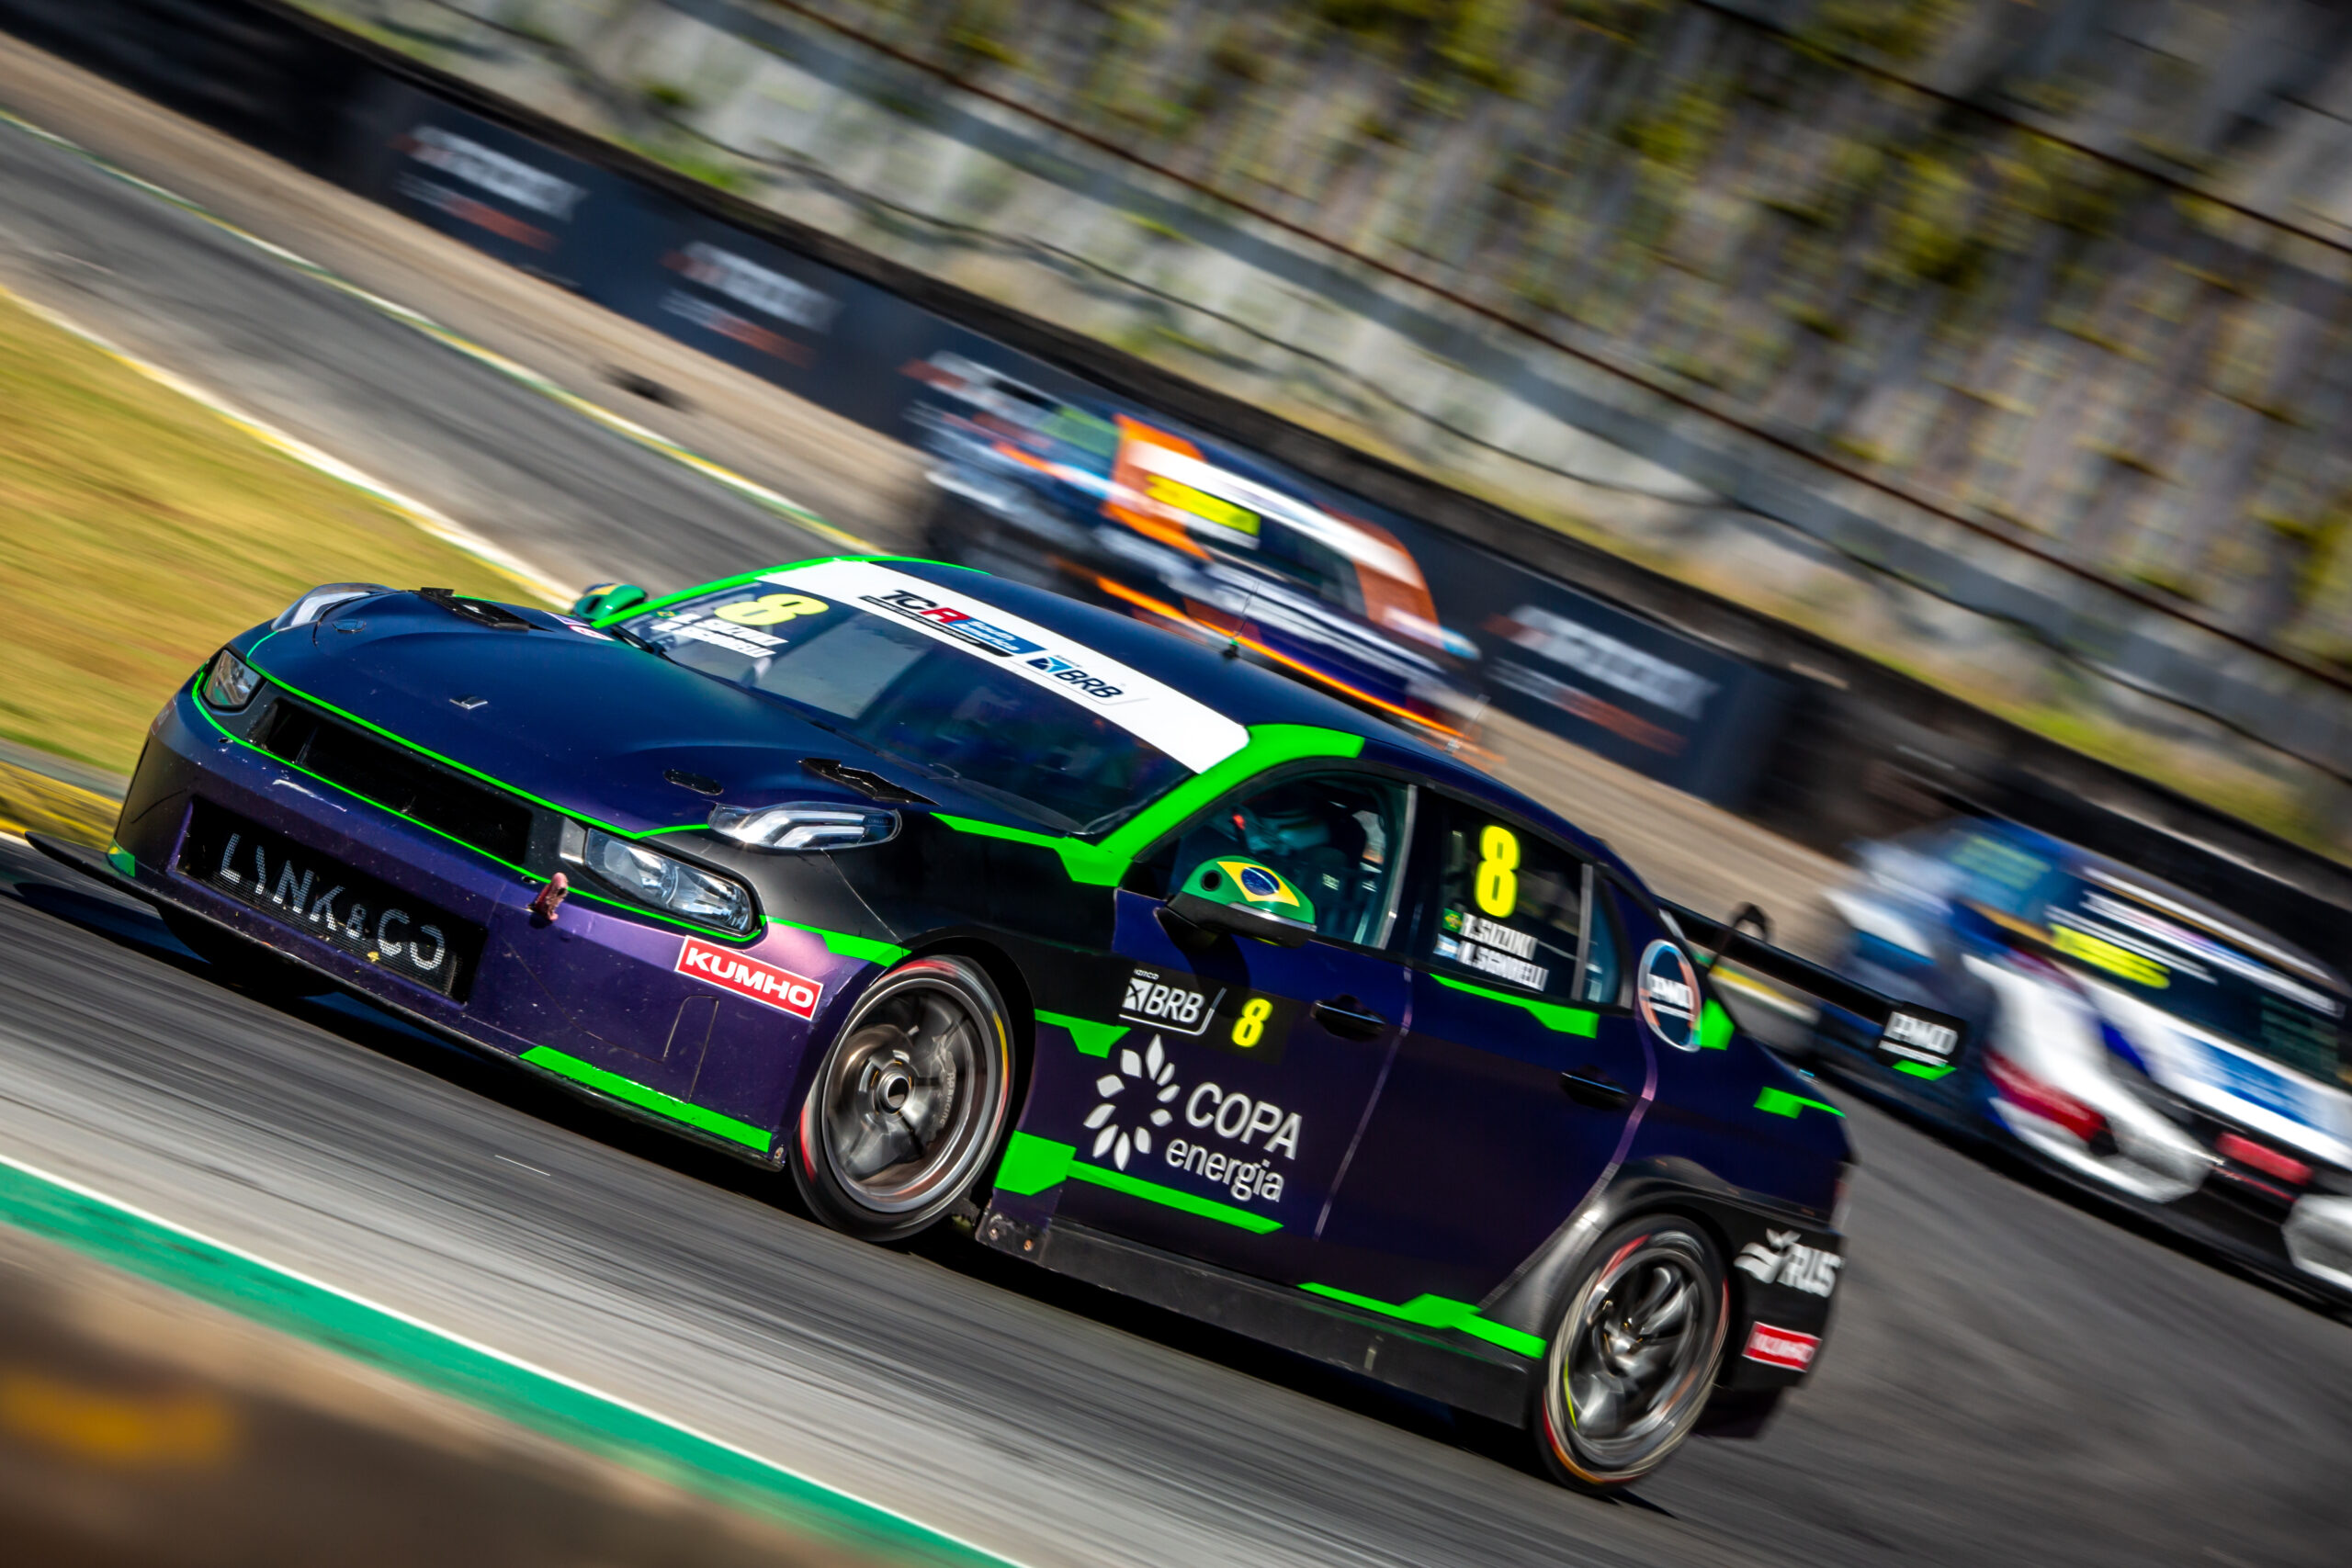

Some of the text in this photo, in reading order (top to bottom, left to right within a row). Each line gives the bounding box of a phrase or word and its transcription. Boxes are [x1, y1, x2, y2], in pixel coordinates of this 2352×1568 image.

[714, 593, 830, 626] 8
[881, 589, 970, 624] TCR
[1053, 670, 1124, 698] BRB
[1475, 825, 1521, 918] 8
[685, 947, 815, 1009] KUMHO
[1144, 985, 1205, 1023] BRB
[1232, 998, 1273, 1047] 8
[1185, 1082, 1303, 1160] COPA
[1166, 1138, 1285, 1202] energia
